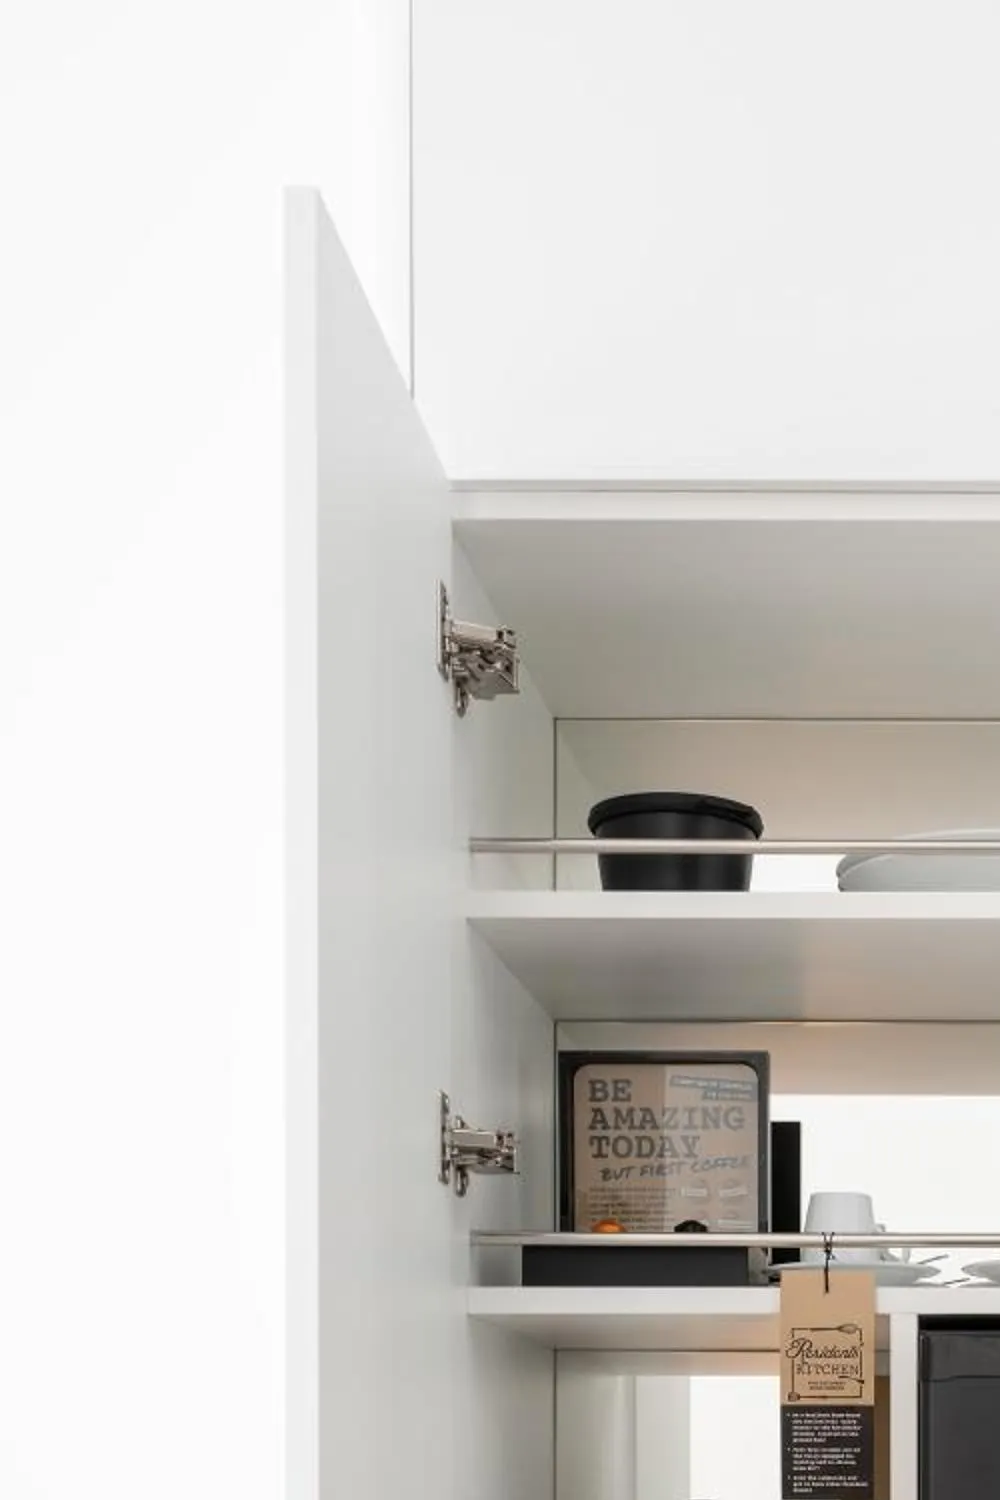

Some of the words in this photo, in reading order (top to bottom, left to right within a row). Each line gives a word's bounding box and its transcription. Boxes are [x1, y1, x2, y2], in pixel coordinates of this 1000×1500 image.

[588, 1079, 632, 1102] BE
[588, 1106, 745, 1131] AMAZING
[588, 1135, 700, 1159] TODAY
[599, 1165, 636, 1182] BUT
[639, 1161, 688, 1178] FIRST
[796, 1361, 859, 1376] KITCHEN
